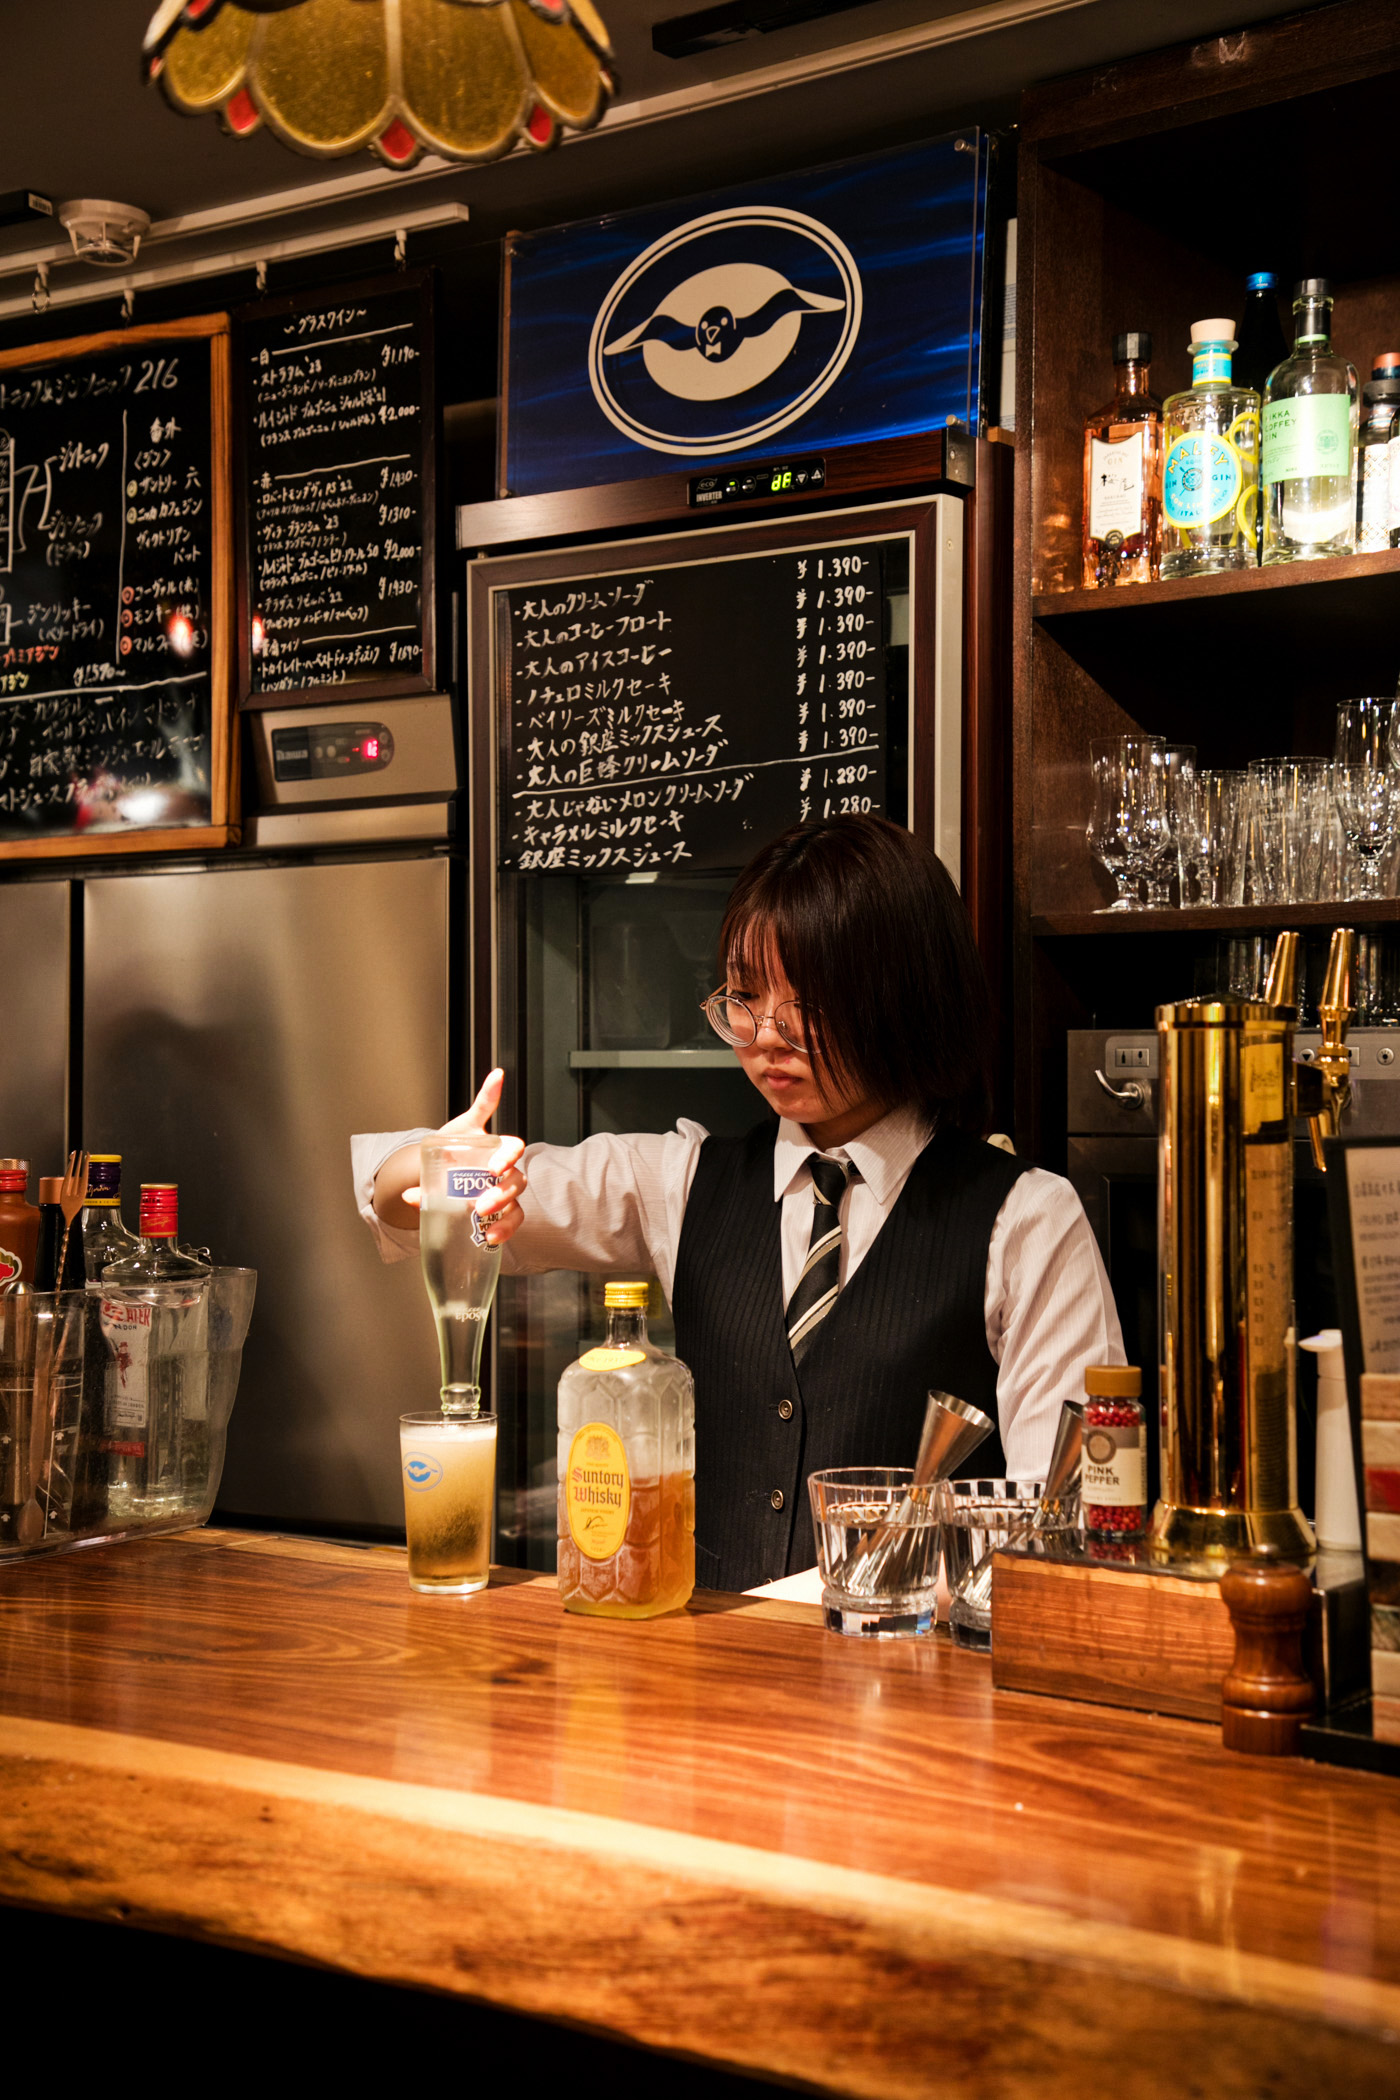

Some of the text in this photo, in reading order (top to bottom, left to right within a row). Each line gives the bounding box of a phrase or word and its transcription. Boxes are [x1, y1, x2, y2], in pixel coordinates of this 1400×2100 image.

[572, 1467, 624, 1489] Suntory
[1087, 1464, 1113, 1475] PINK
[1084, 1473, 1120, 1485] PEPPER
[573, 1485, 622, 1508] Whisky
